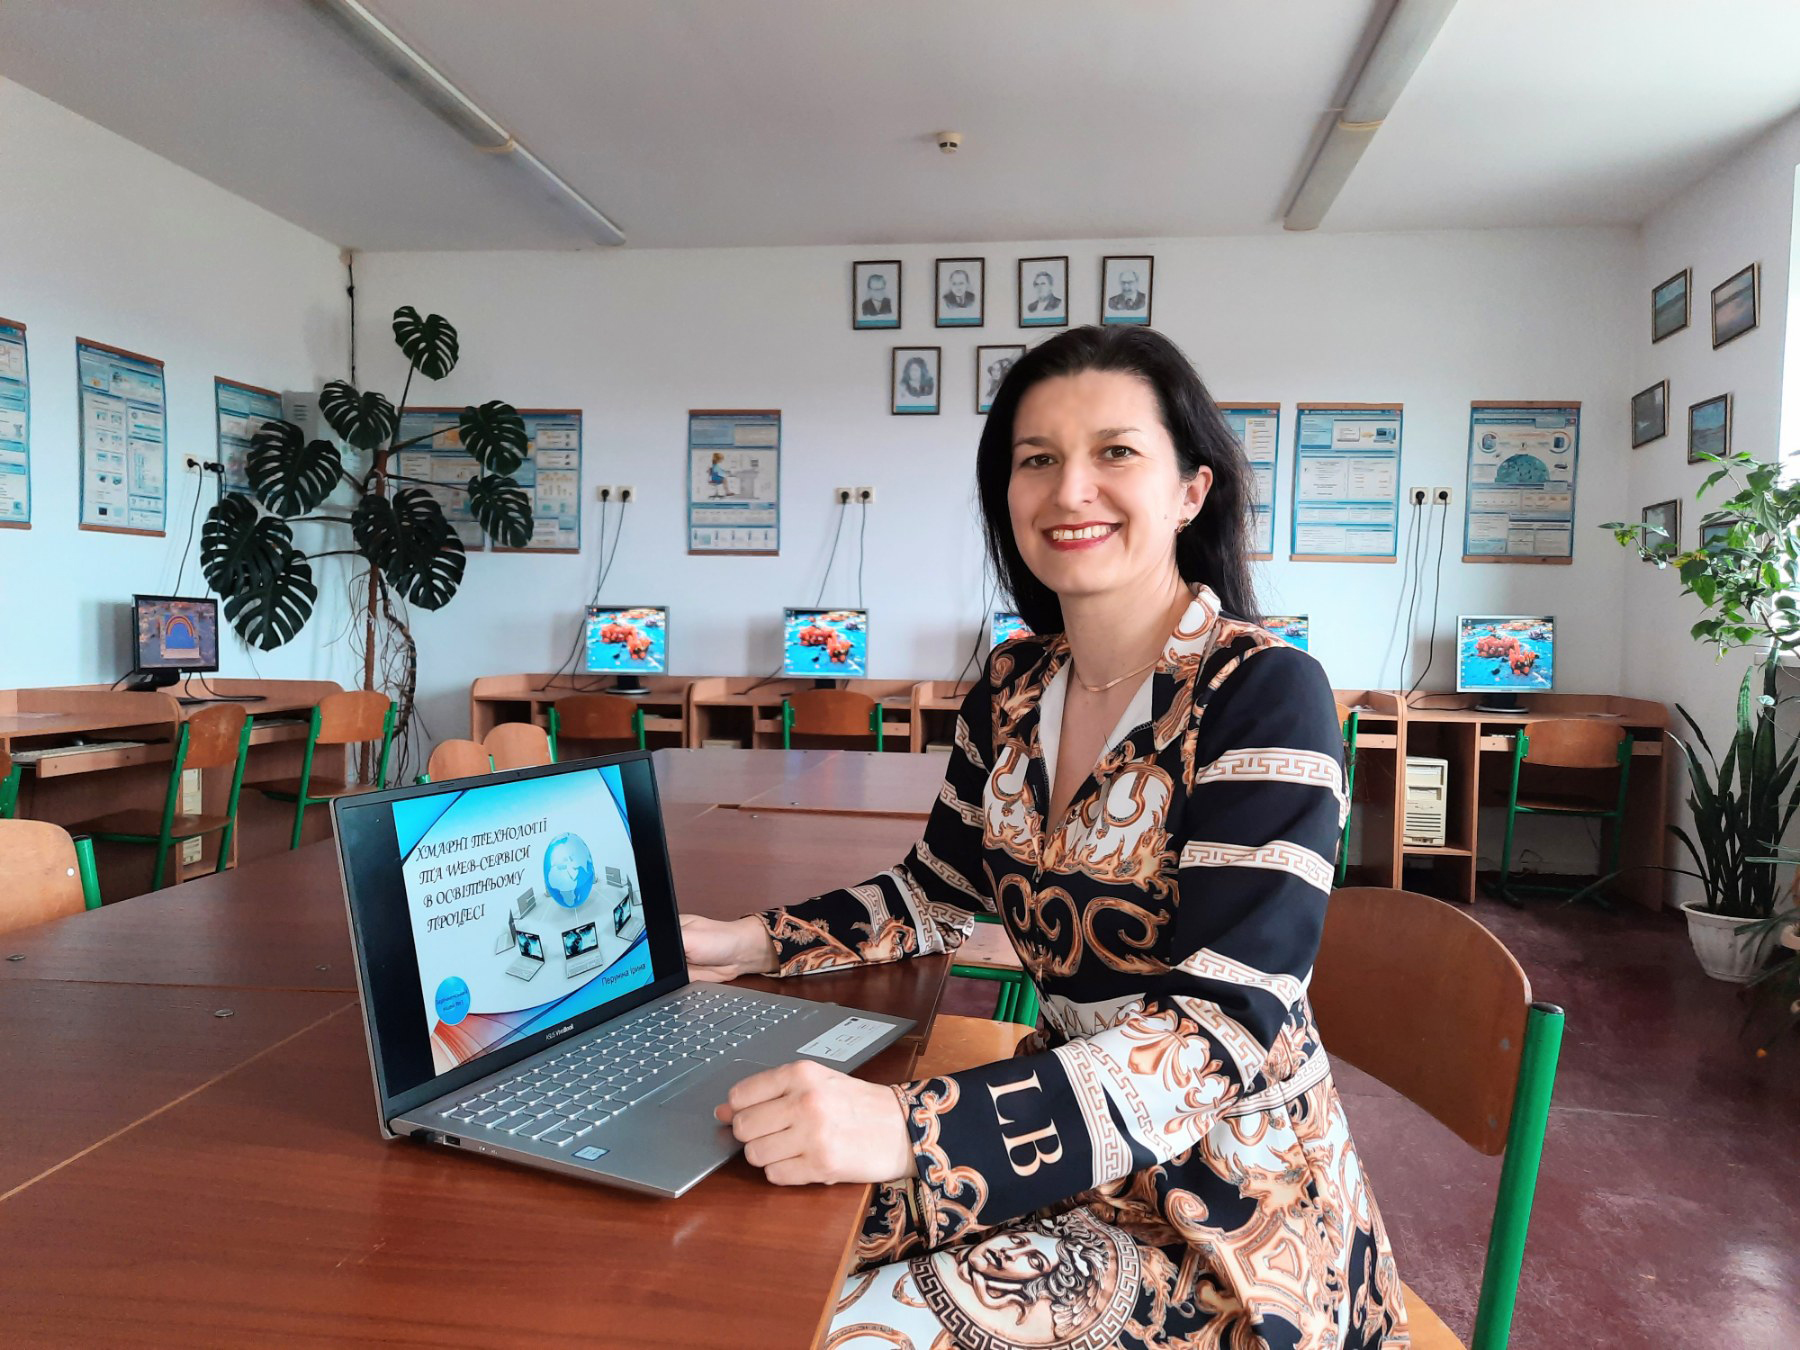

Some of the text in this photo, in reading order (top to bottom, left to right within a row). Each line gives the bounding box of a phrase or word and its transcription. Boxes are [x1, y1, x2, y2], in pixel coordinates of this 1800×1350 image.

[416, 817, 547, 861] ХМАРНІ ТЕХНОЛОГІЇ
[419, 845, 531, 885] ТА WEB-СЕРВІСИ
[423, 868, 525, 908] В ОСВІТНЬОМУ
[427, 904, 485, 933] ПРОЦЕСІ
[986, 1069, 1063, 1176] LB
